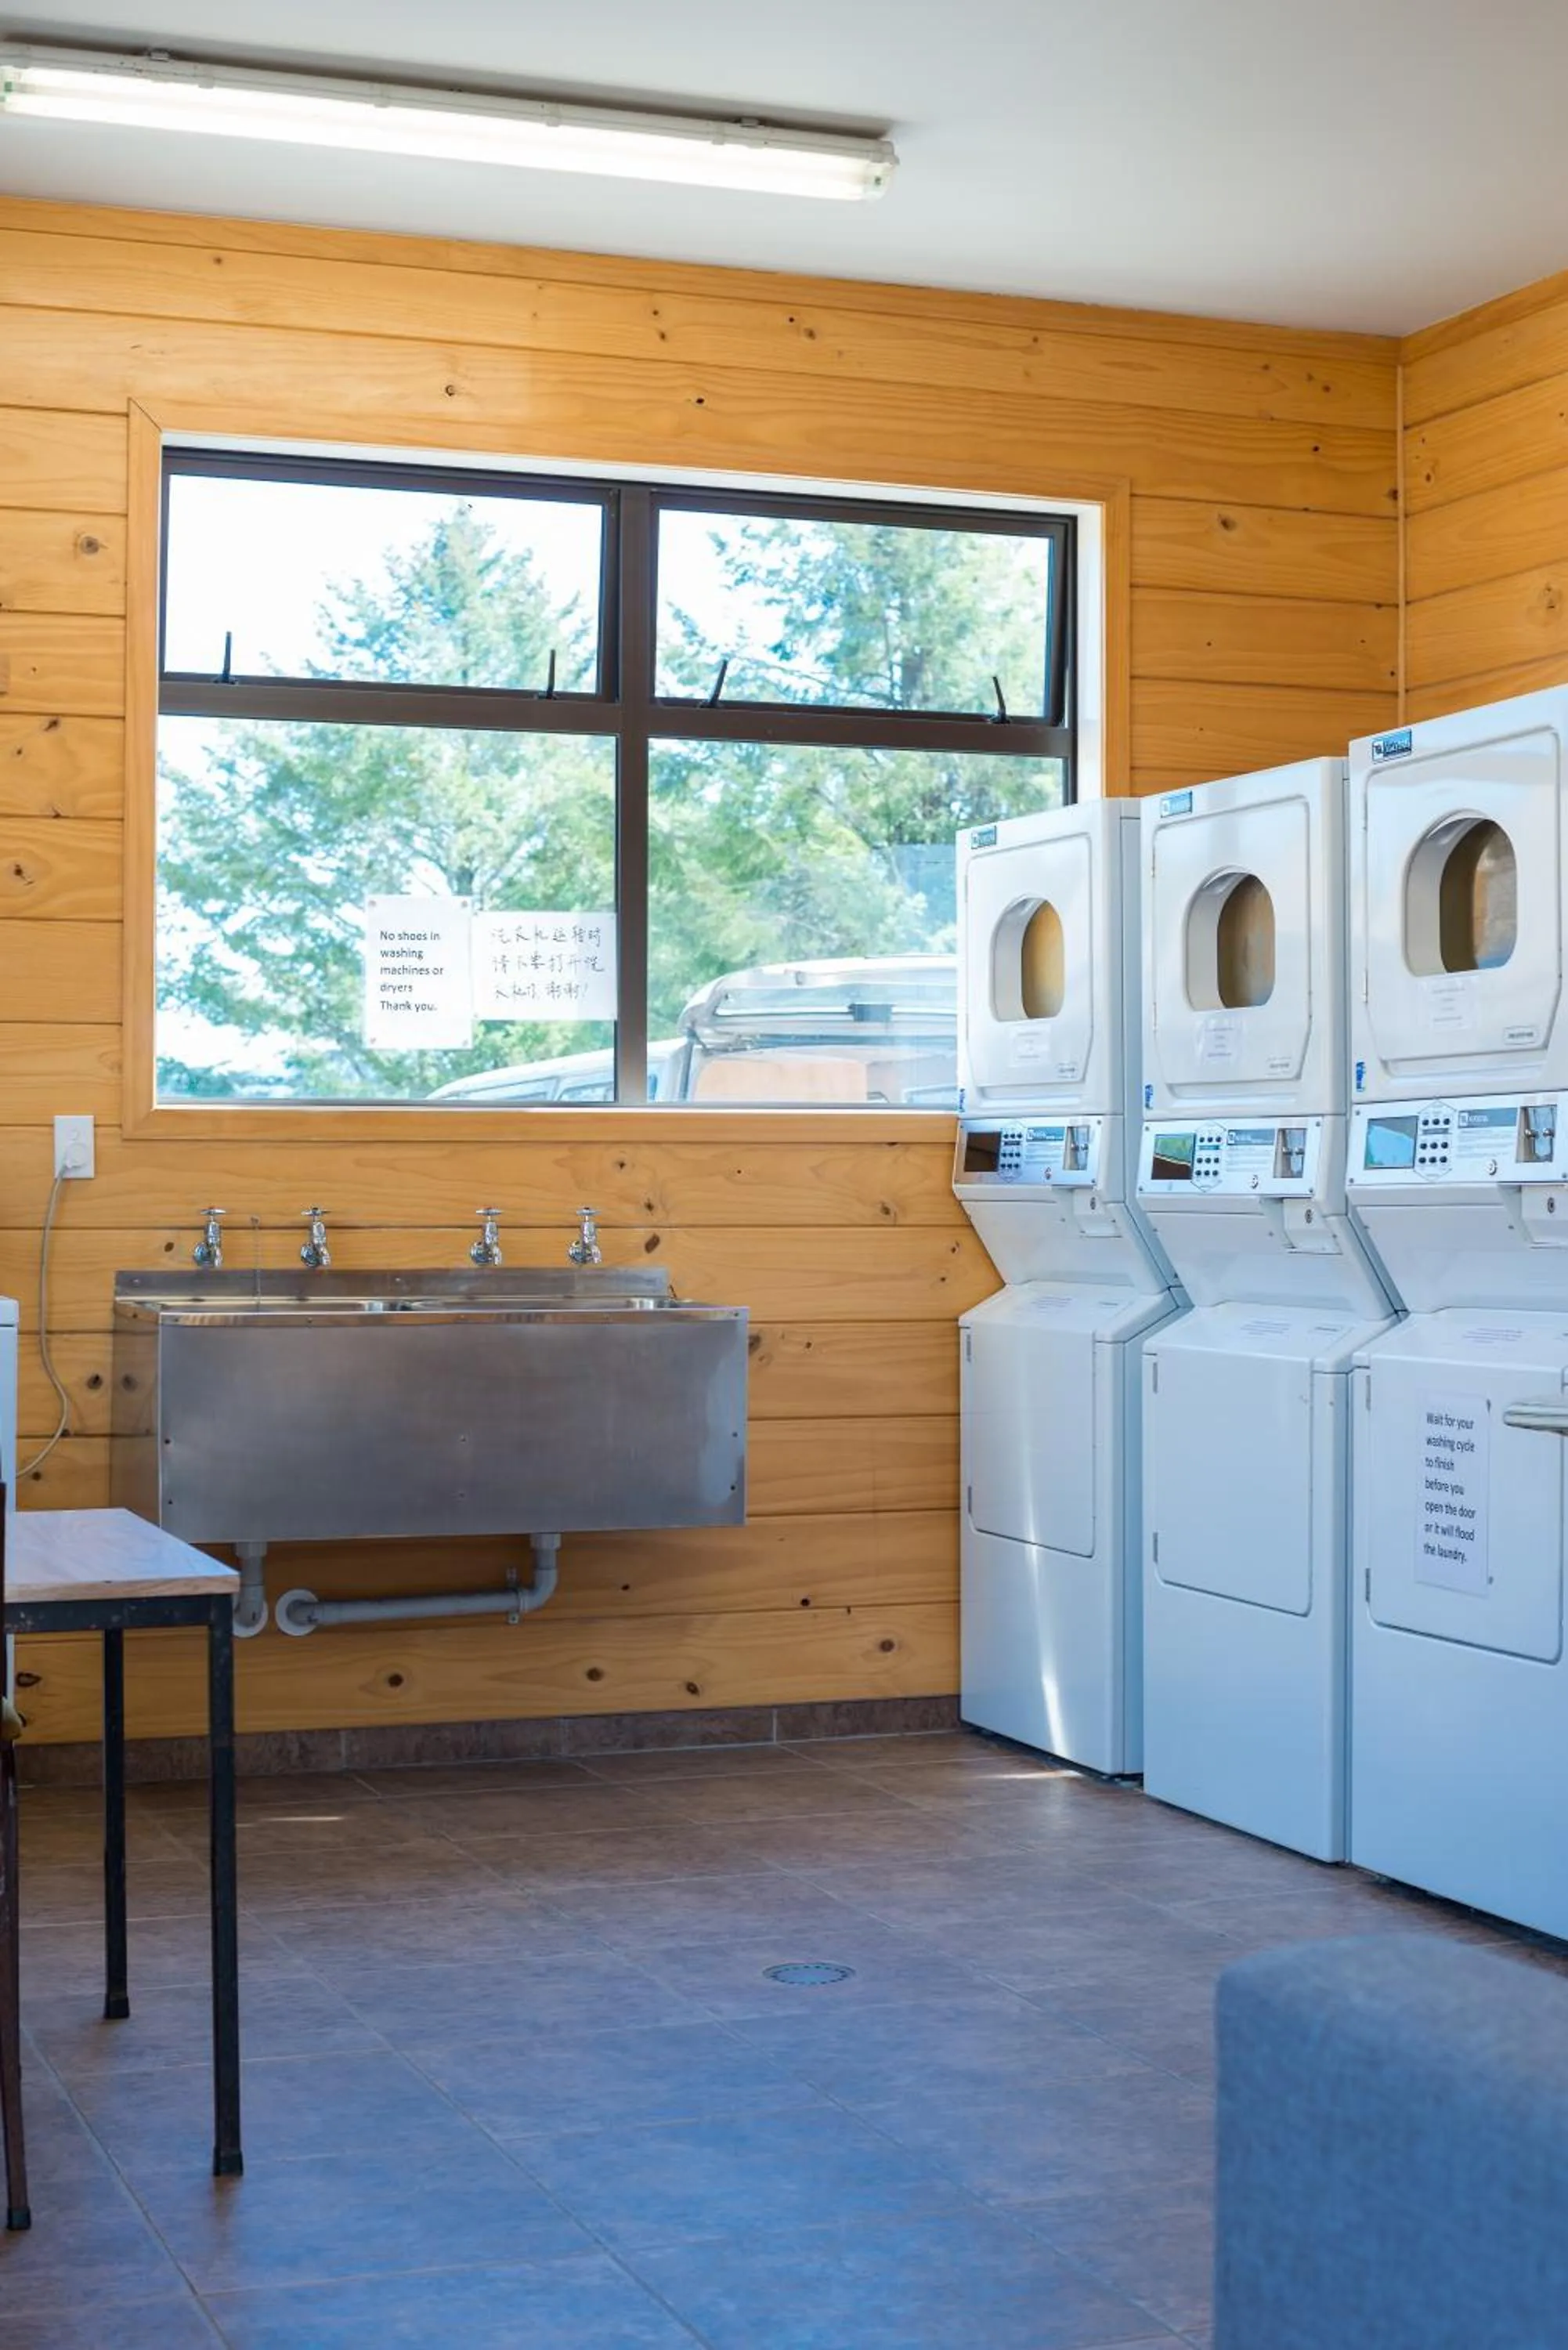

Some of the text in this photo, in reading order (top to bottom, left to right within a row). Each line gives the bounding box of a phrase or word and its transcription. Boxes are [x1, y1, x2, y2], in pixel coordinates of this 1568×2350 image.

[380, 930, 441, 941] No shoes in
[380, 946, 424, 961] washing
[380, 964, 444, 975] machines or
[380, 982, 414, 995] dryers
[380, 1000, 438, 1013] Thank you.
[1426, 1412, 1474, 1430] Wait for your
[1426, 1434, 1475, 1453] washing cycle
[1425, 1456, 1454, 1471] to finish
[1425, 1477, 1465, 1496] before you
[1425, 1502, 1476, 1519] open the door
[1424, 1522, 1474, 1542] or it will flood
[1424, 1542, 1436, 1555] the
